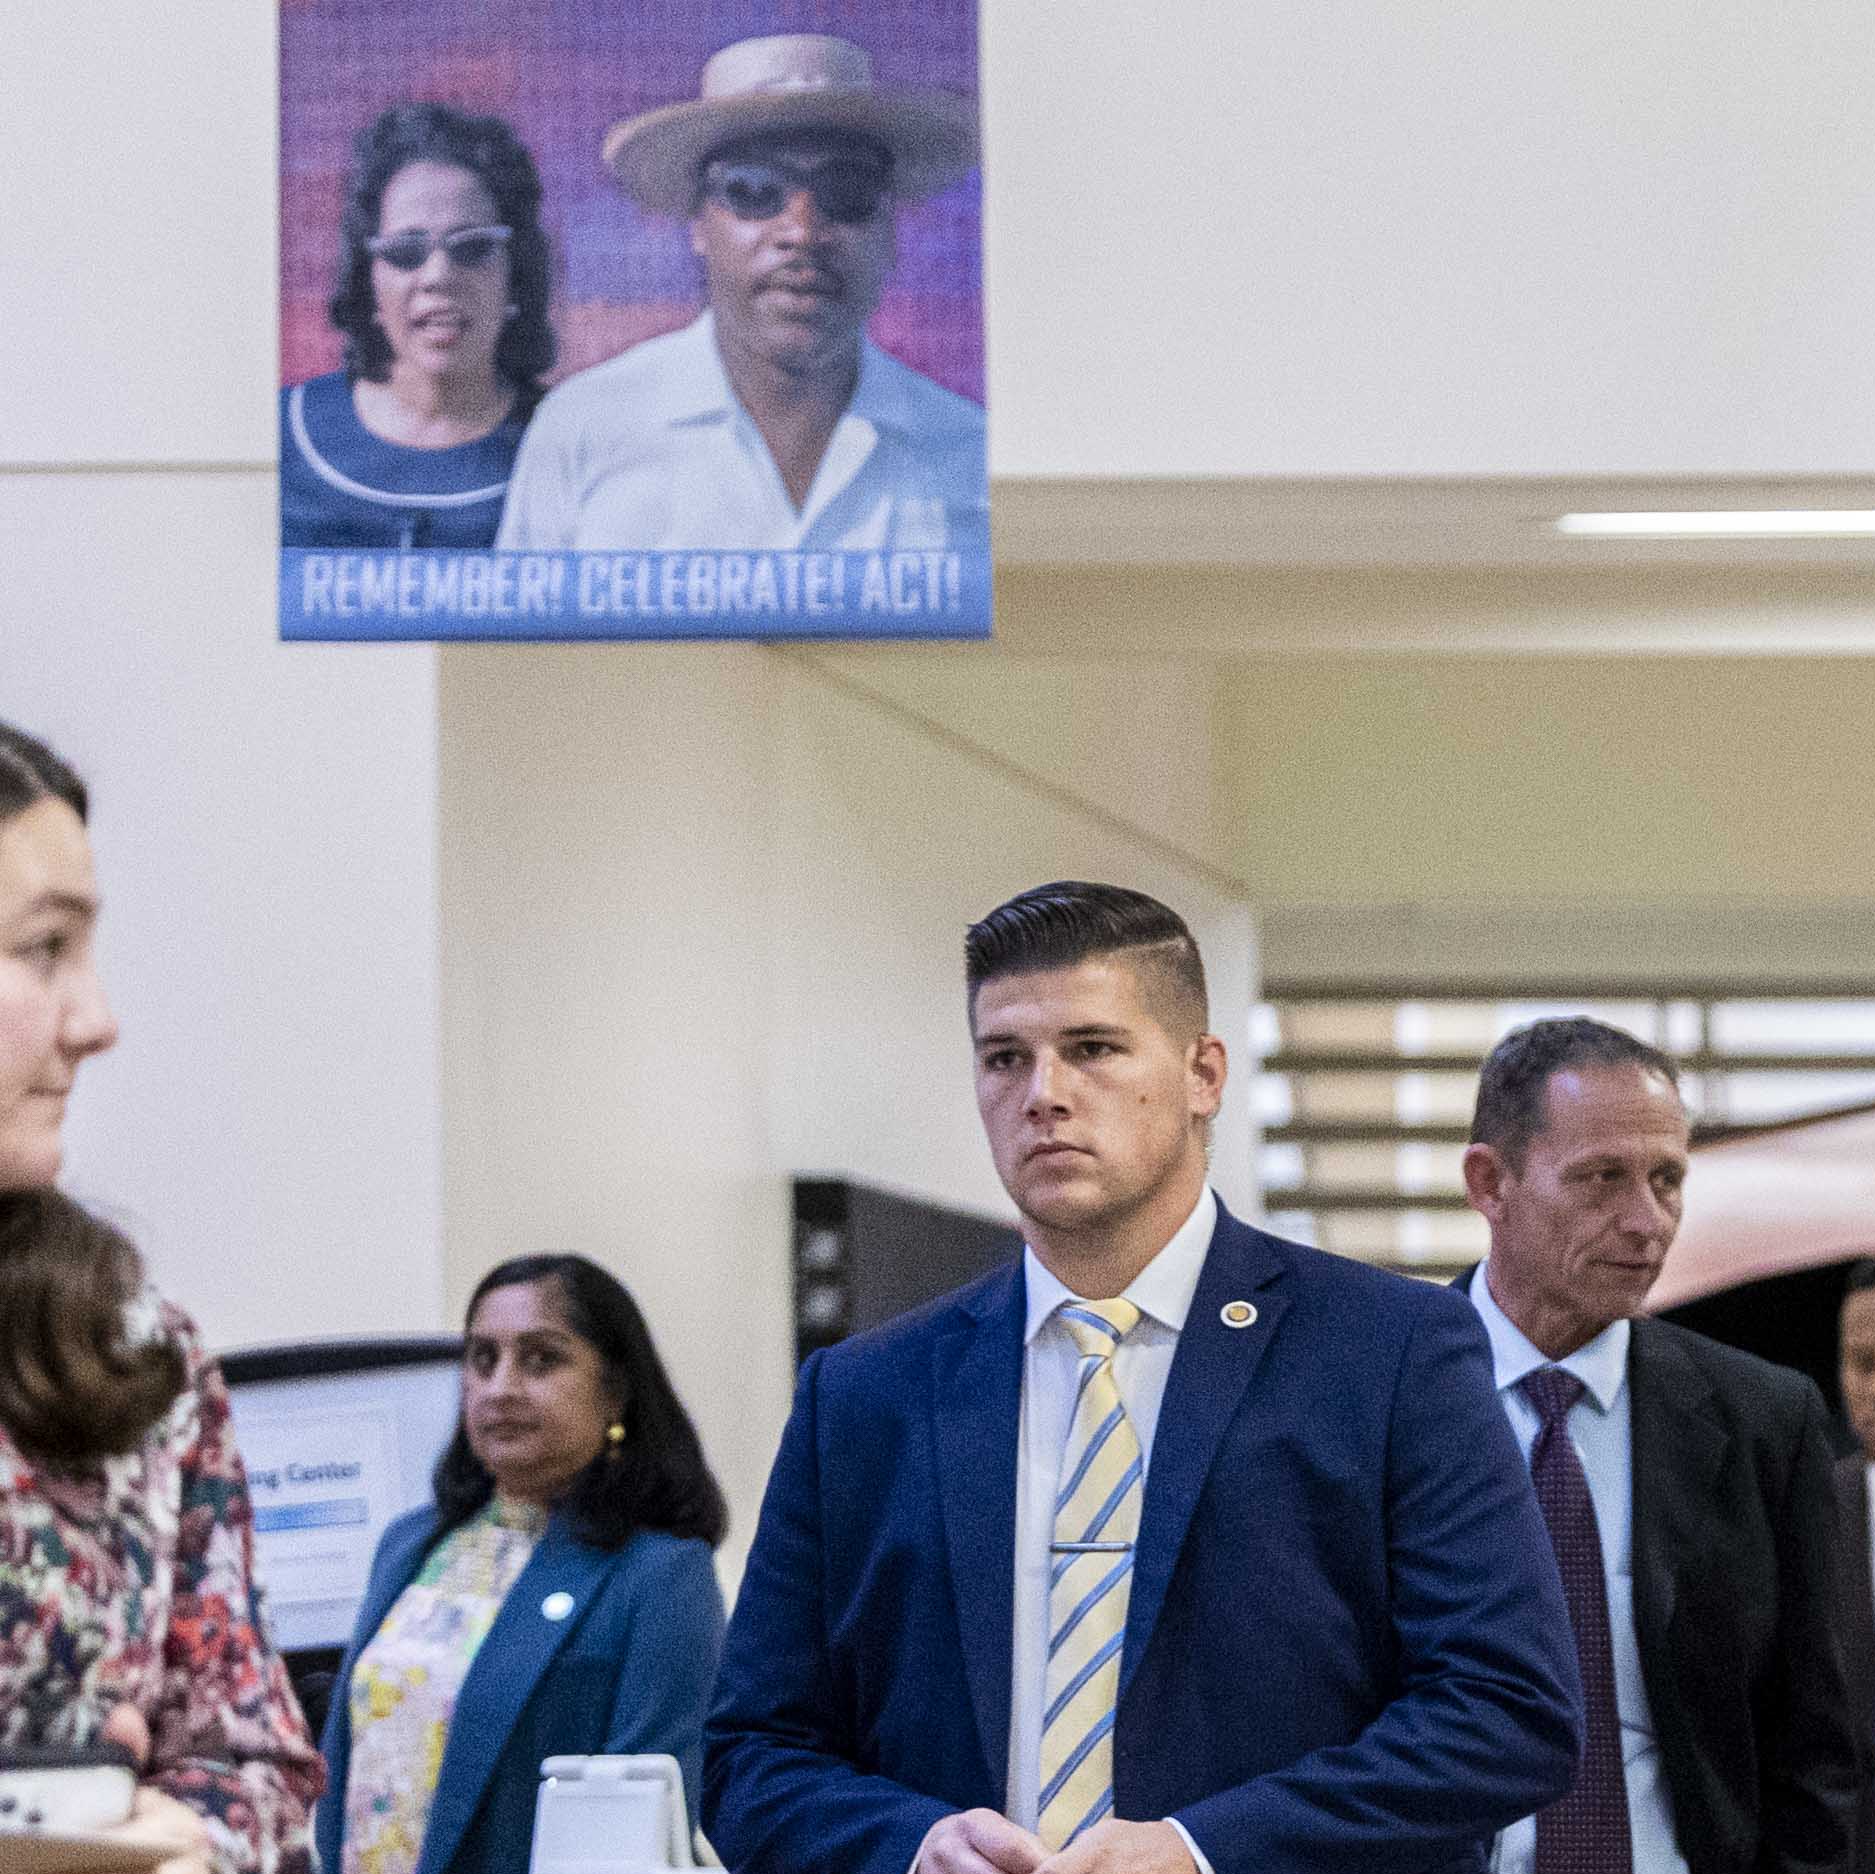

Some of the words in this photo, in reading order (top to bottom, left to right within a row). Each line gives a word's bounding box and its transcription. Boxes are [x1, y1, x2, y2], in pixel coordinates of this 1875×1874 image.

[303, 552, 562, 618] REMEMBER!
[578, 551, 844, 615] CELEBRATE!
[861, 549, 962, 613] ACT!
